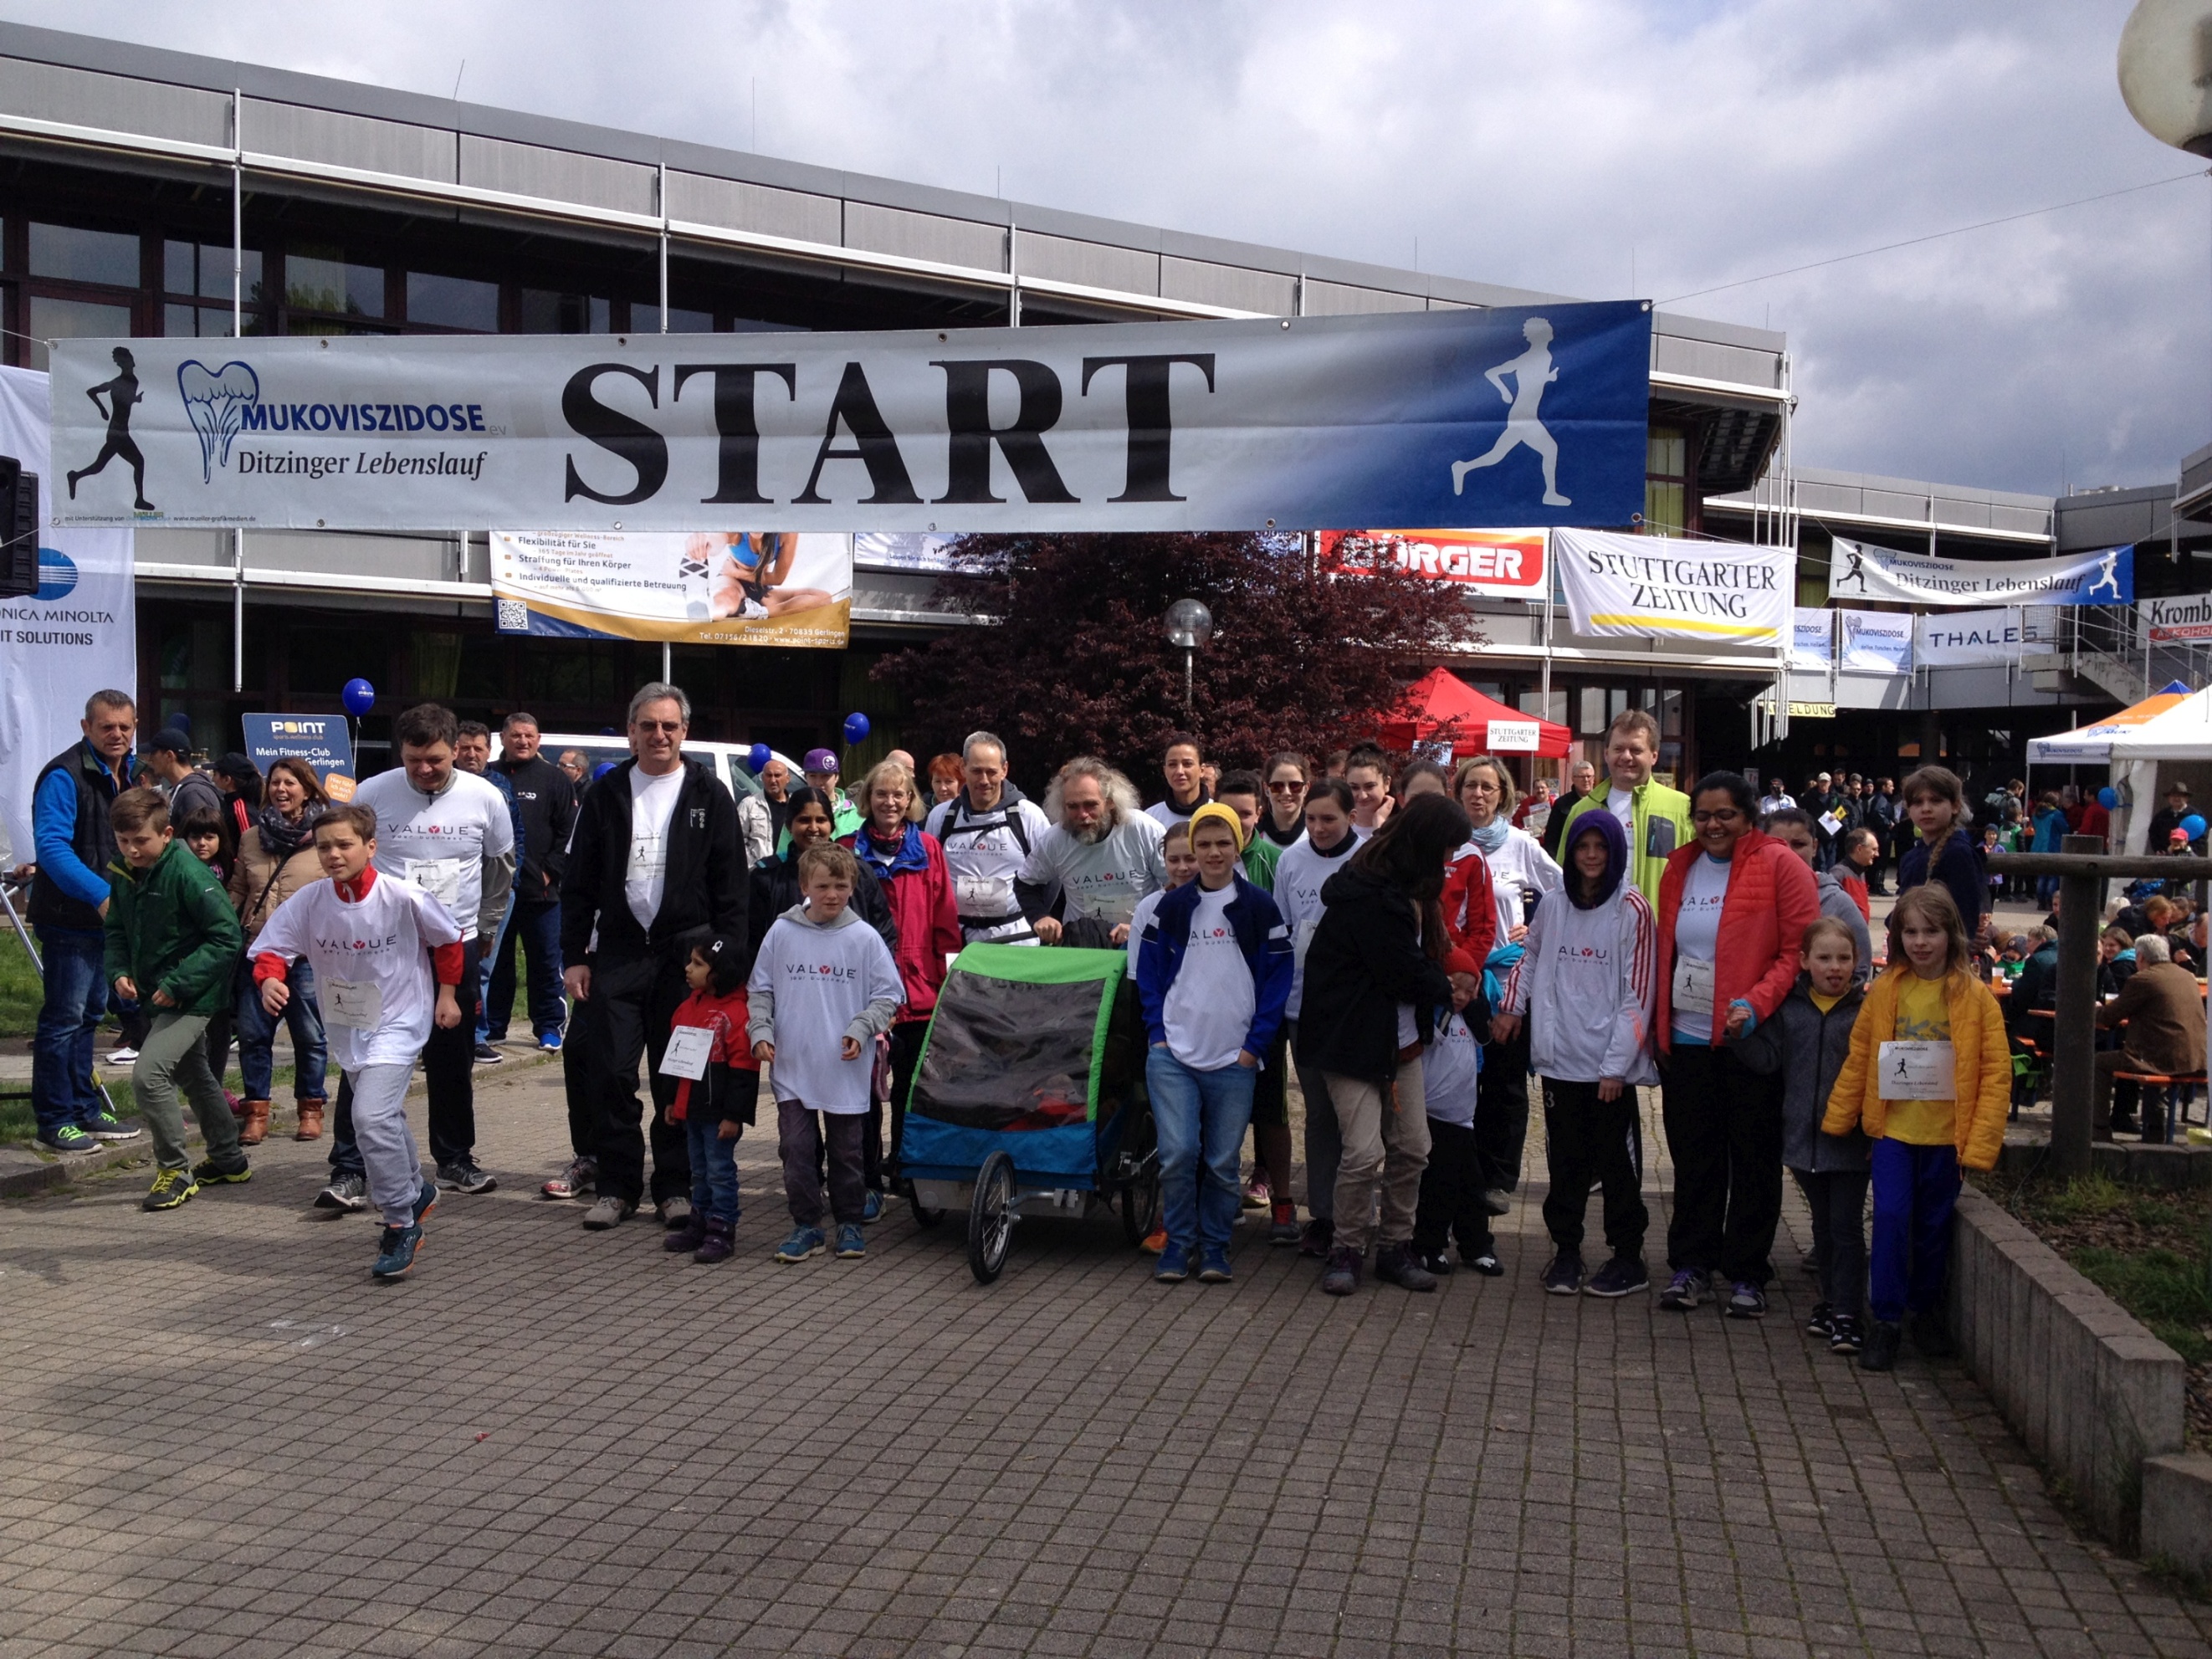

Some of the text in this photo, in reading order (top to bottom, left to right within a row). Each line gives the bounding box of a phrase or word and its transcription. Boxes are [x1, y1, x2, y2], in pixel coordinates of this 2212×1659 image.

[240, 404, 486, 432] MUKOVISZIDOSE
[561, 353, 1216, 505] START
[238, 450, 488, 481] Ditzinger Lebenslauf
[519, 536, 597, 550] Flexibilität für Sie
[519, 555, 561, 566] Straffung
[578, 559, 600, 567] Ihren
[602, 560, 632, 571] Körper
[1588, 550, 1778, 591] STUTTGARTER
[1889, 559, 1954, 571] MUKOVISZIDOSE
[520, 572, 570, 583] Individuelle
[590, 577, 642, 587] qualifizierte
[644, 580, 686, 592] Betreuung
[1896, 572, 2087, 595] Ditzinger Lebenslauf
[1630, 581, 1748, 618] ZEITUNG
[0, 607, 114, 623] NICA MINOLTA
[2150, 597, 2212, 625] Kromb
[745, 626, 776, 634] Dieselstr.
[789, 627, 813, 636] 70839
[814, 628, 845, 639] Gerlingen
[1794, 624, 1822, 633] ISZIDOSE
[1856, 627, 1904, 637] MUKOVISZIDOSE
[1, 630, 93, 645] IT SOLUTIONS
[1929, 627, 2038, 648] THALES
[1490, 728, 1536, 736] STUTTGARTER
[256, 747, 330, 756] Mein Fitness-Club
[305, 757, 345, 768] Gerlingen
